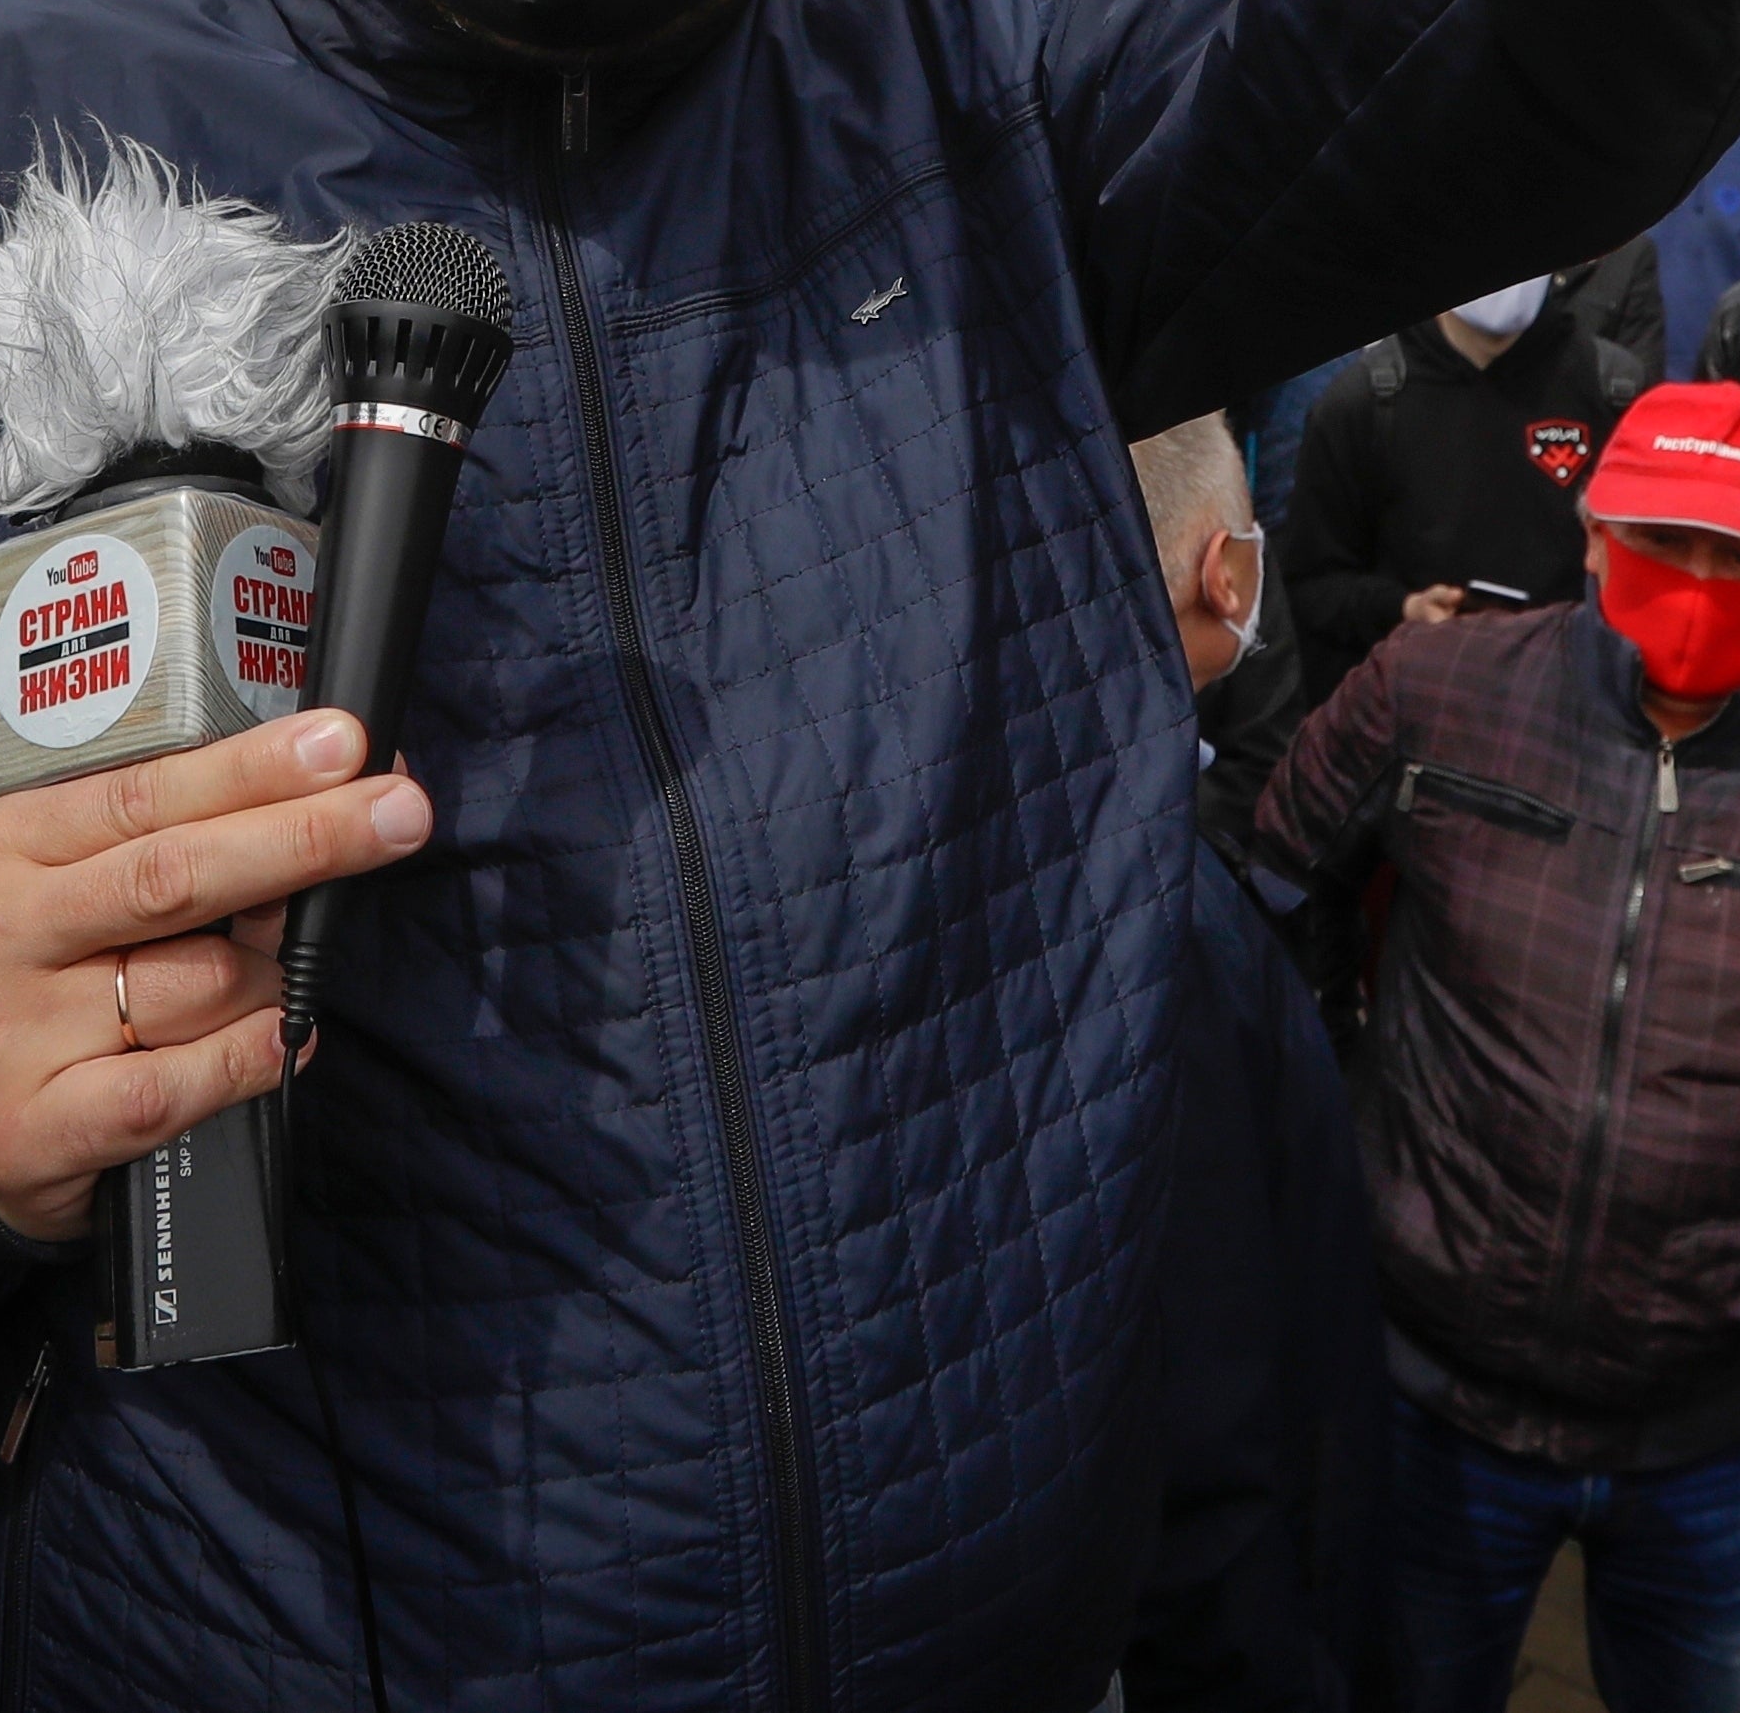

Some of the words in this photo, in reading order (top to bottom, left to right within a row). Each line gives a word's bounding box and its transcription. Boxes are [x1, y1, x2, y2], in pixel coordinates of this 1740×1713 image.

[19, 580, 129, 648] СТРАНА
[19, 644, 131, 716] ЖИЗНИ
[179, 1146, 192, 1177] SKP
[154, 1141, 174, 1283] SENNHEIS
